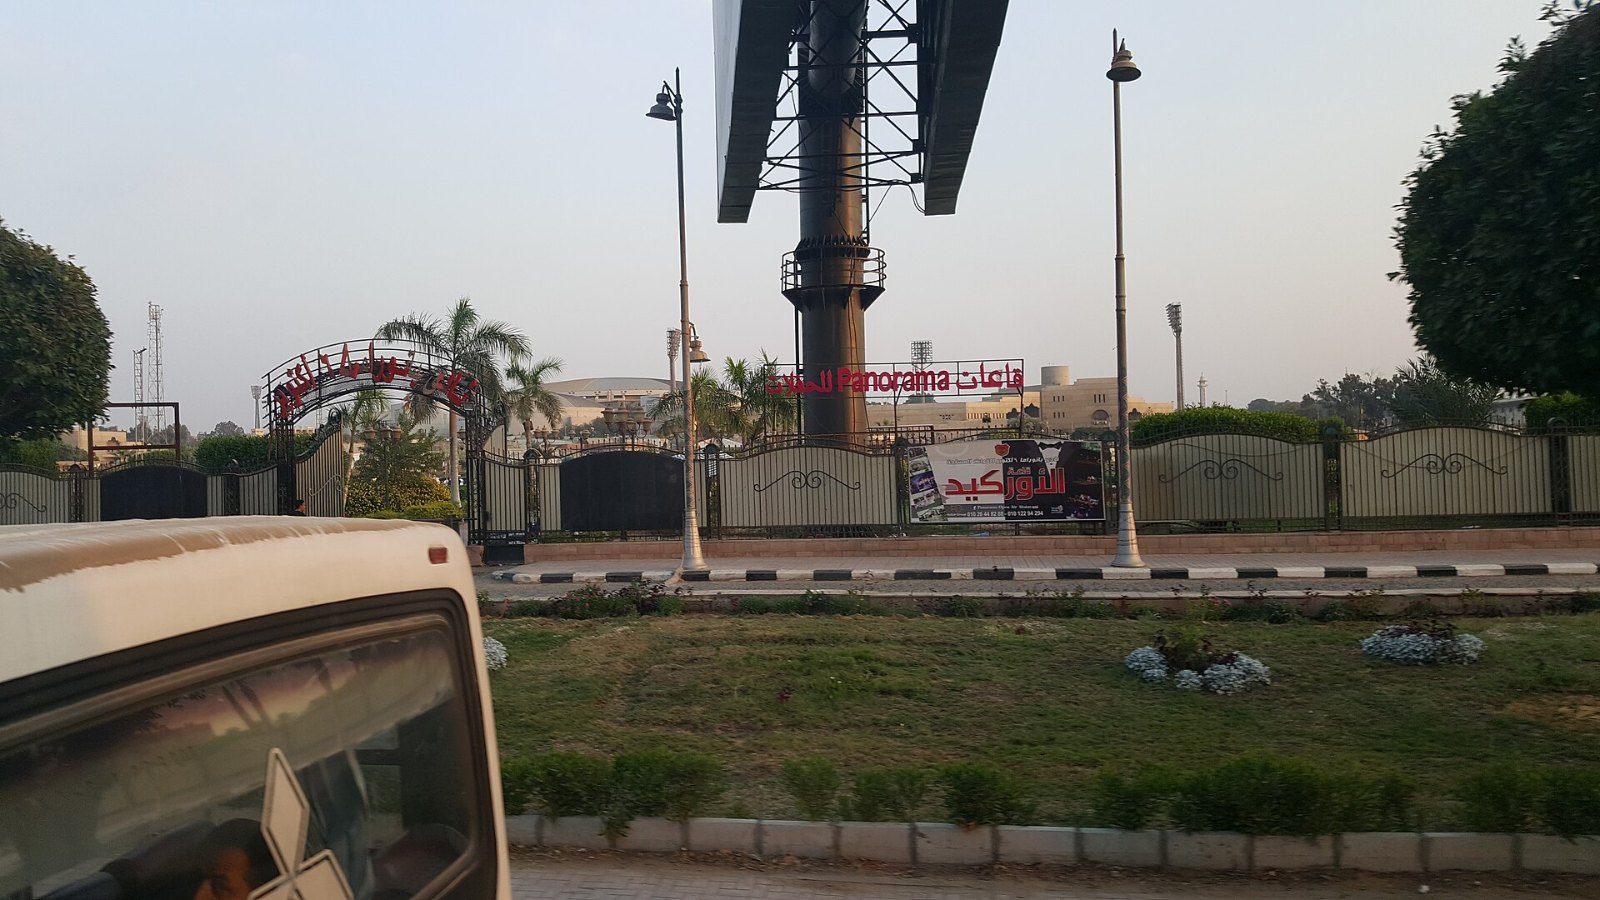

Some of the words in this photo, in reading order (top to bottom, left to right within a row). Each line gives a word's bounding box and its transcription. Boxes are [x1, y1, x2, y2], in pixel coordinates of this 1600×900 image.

[765, 367, 834, 397] للحفلات
[837, 367, 950, 393] Panorama
[956, 361, 1024, 389] قاعات
